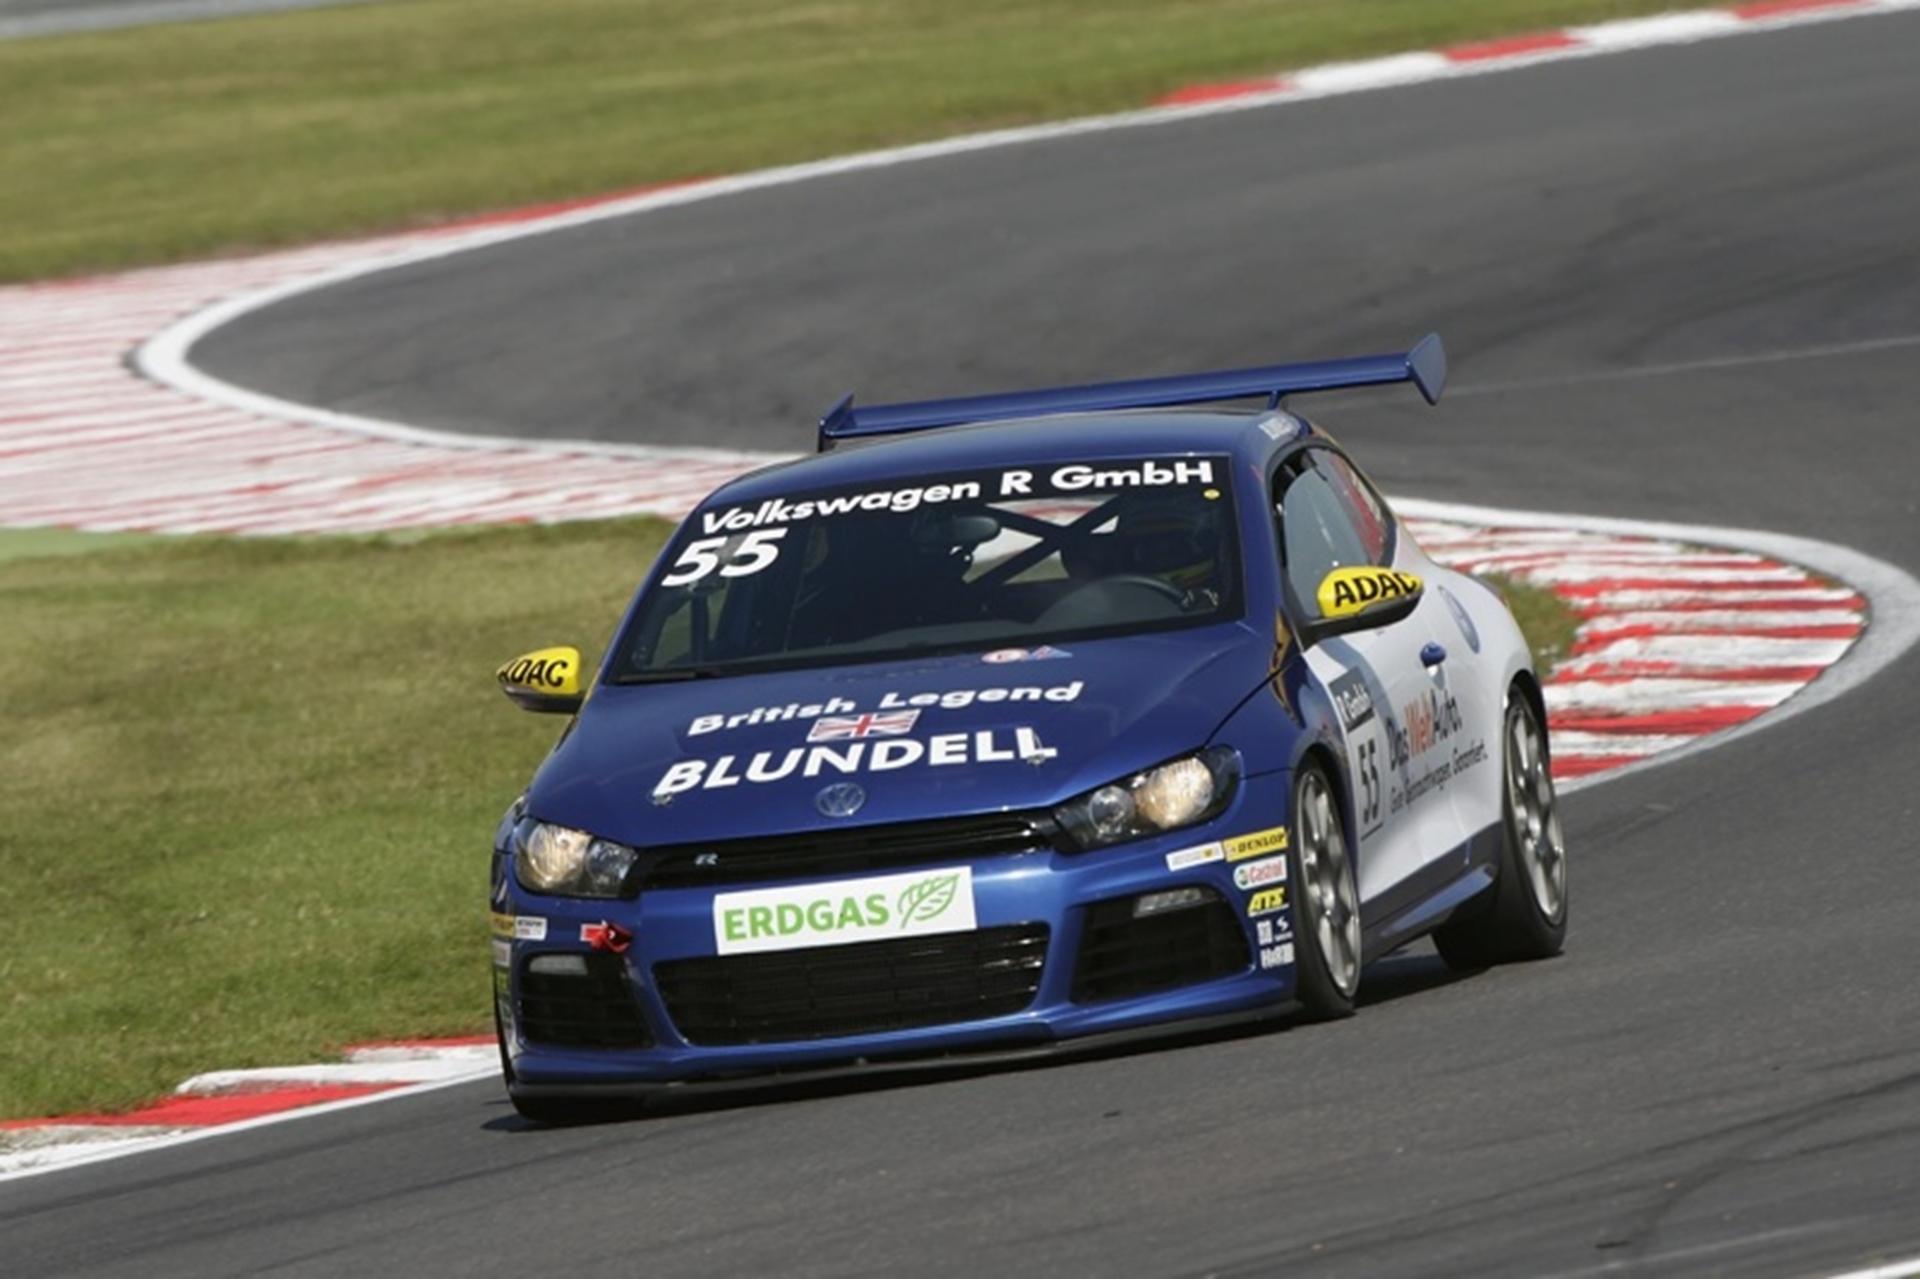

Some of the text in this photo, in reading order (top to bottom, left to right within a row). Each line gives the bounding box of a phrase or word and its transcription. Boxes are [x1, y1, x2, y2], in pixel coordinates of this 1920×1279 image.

[703, 460, 1213, 534] Volkswagen R GmbH
[661, 527, 788, 587] 55
[1334, 571, 1417, 607] ADAC
[687, 681, 1084, 736] British Legend
[652, 727, 1057, 796] BLUNDELL
[1358, 738, 1379, 824] 55
[1238, 833, 1285, 853] DUNLOP
[724, 894, 890, 941] ERDGAS
